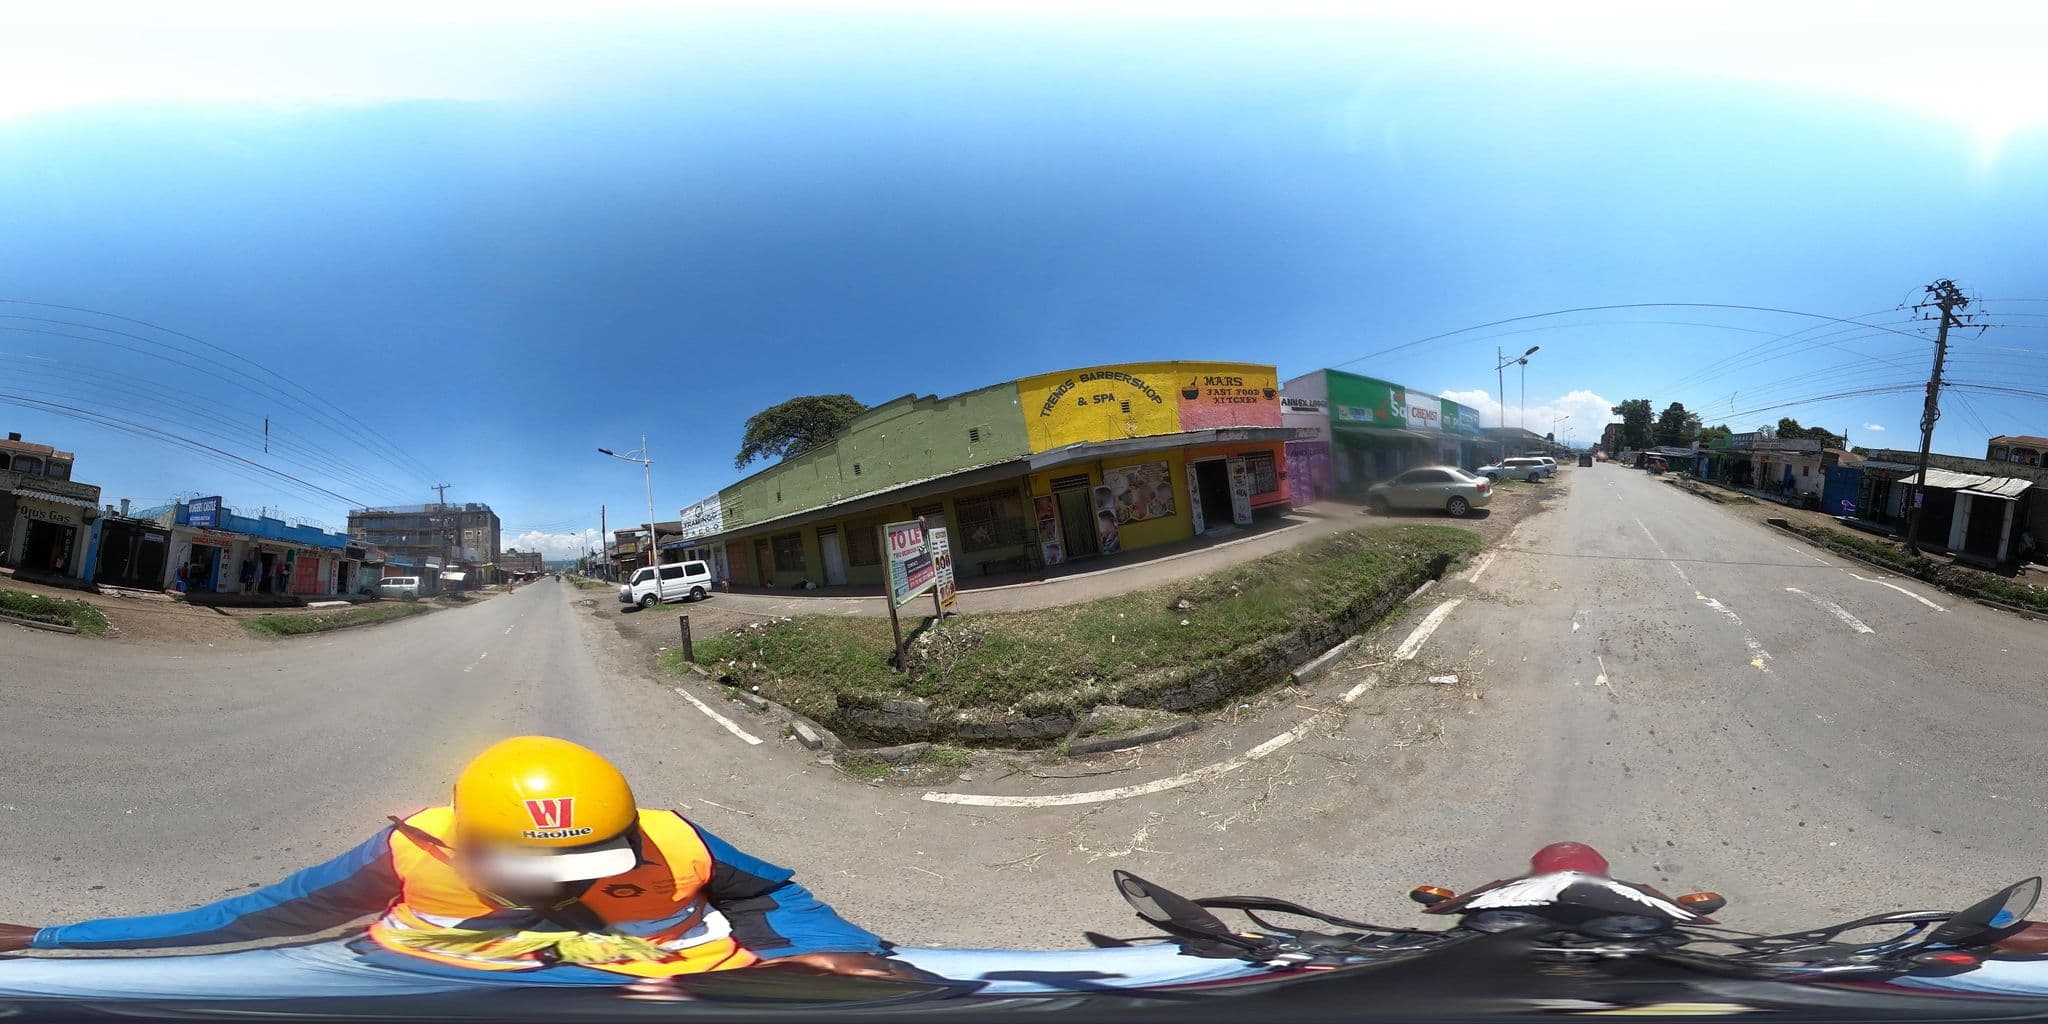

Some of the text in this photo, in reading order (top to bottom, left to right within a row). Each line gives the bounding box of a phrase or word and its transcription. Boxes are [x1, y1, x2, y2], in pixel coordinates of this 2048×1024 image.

[1203, 376, 1243, 387] MARS
[1040, 371, 1163, 417] TRENDS BARBERSHOP
[1077, 393, 1115, 406] & SPA
[1412, 406, 1438, 422] CHEMIST
[49, 510, 71, 523] Gas
[889, 527, 921, 551] TO LE
